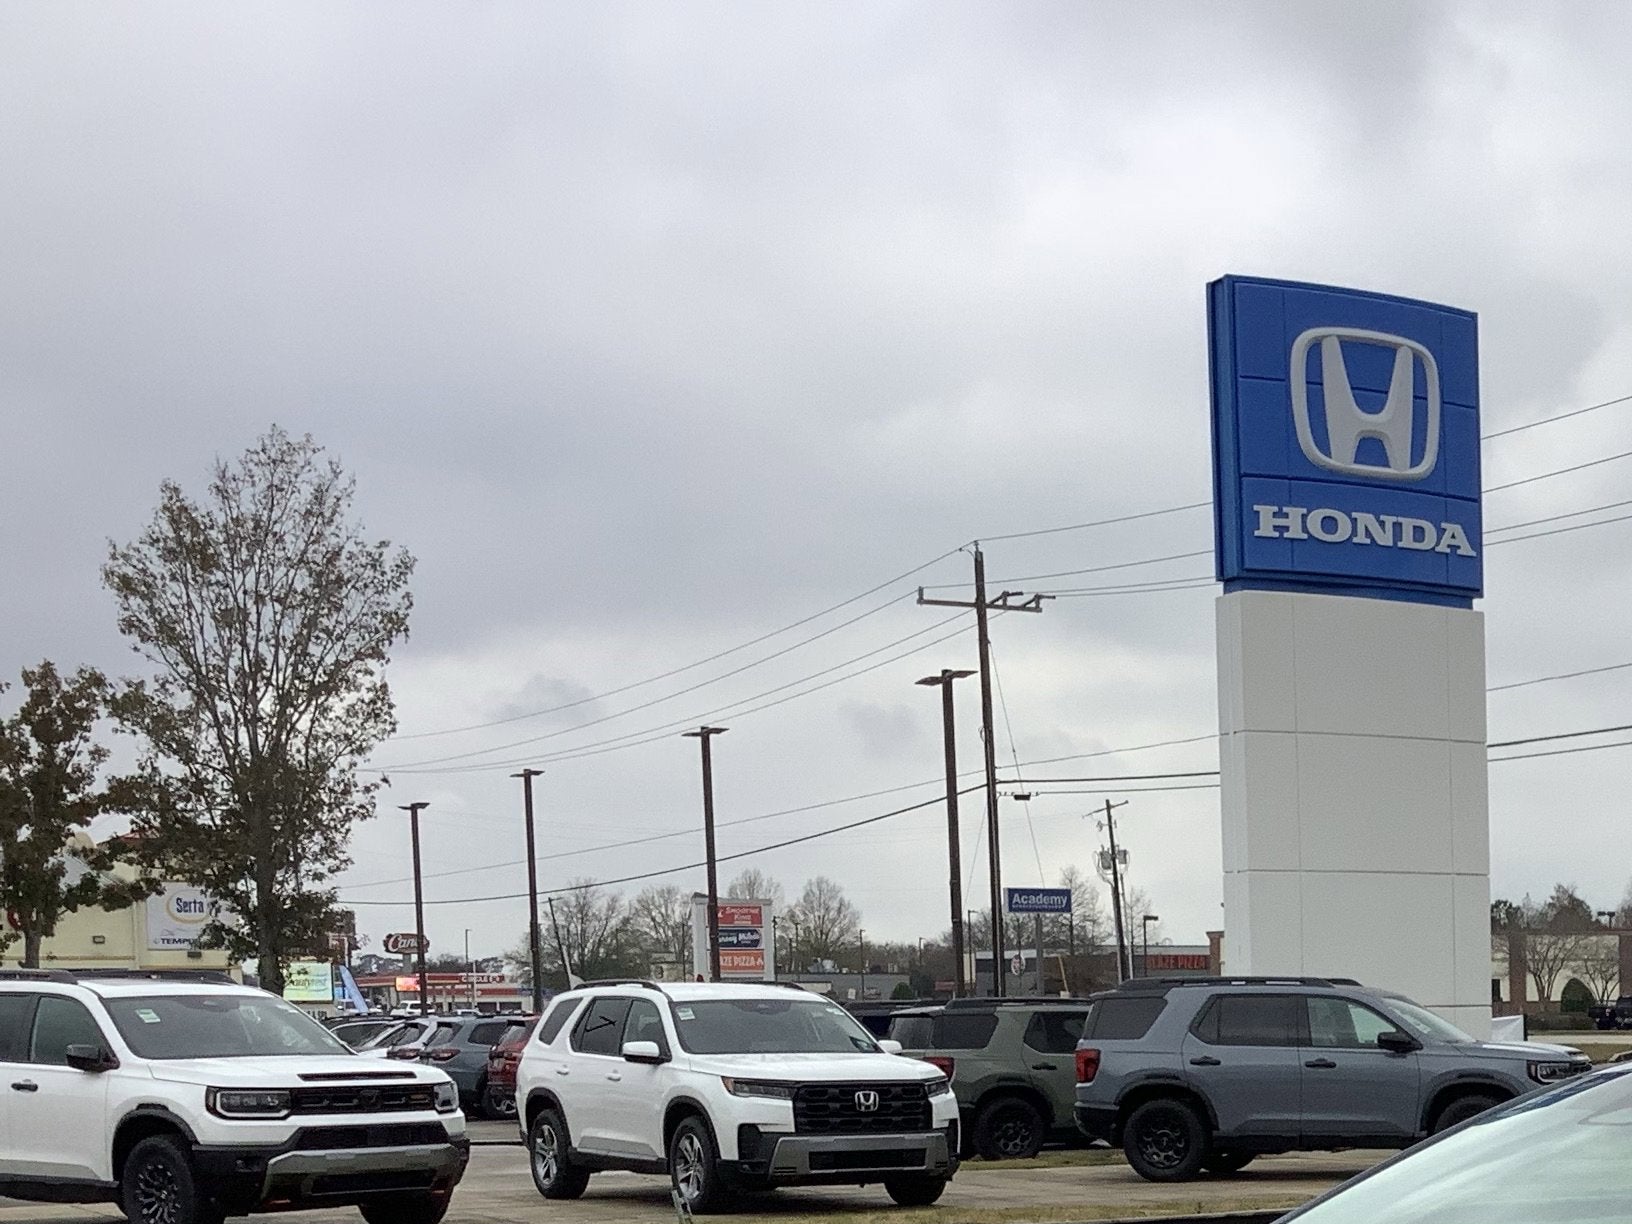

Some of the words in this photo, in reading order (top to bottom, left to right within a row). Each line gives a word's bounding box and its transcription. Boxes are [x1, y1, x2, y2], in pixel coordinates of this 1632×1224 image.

[1253, 504, 1477, 557] HONDA
[176, 897, 204, 913] Serta
[1012, 893, 1068, 908] Academy
[733, 955, 756, 966] PIZZA
